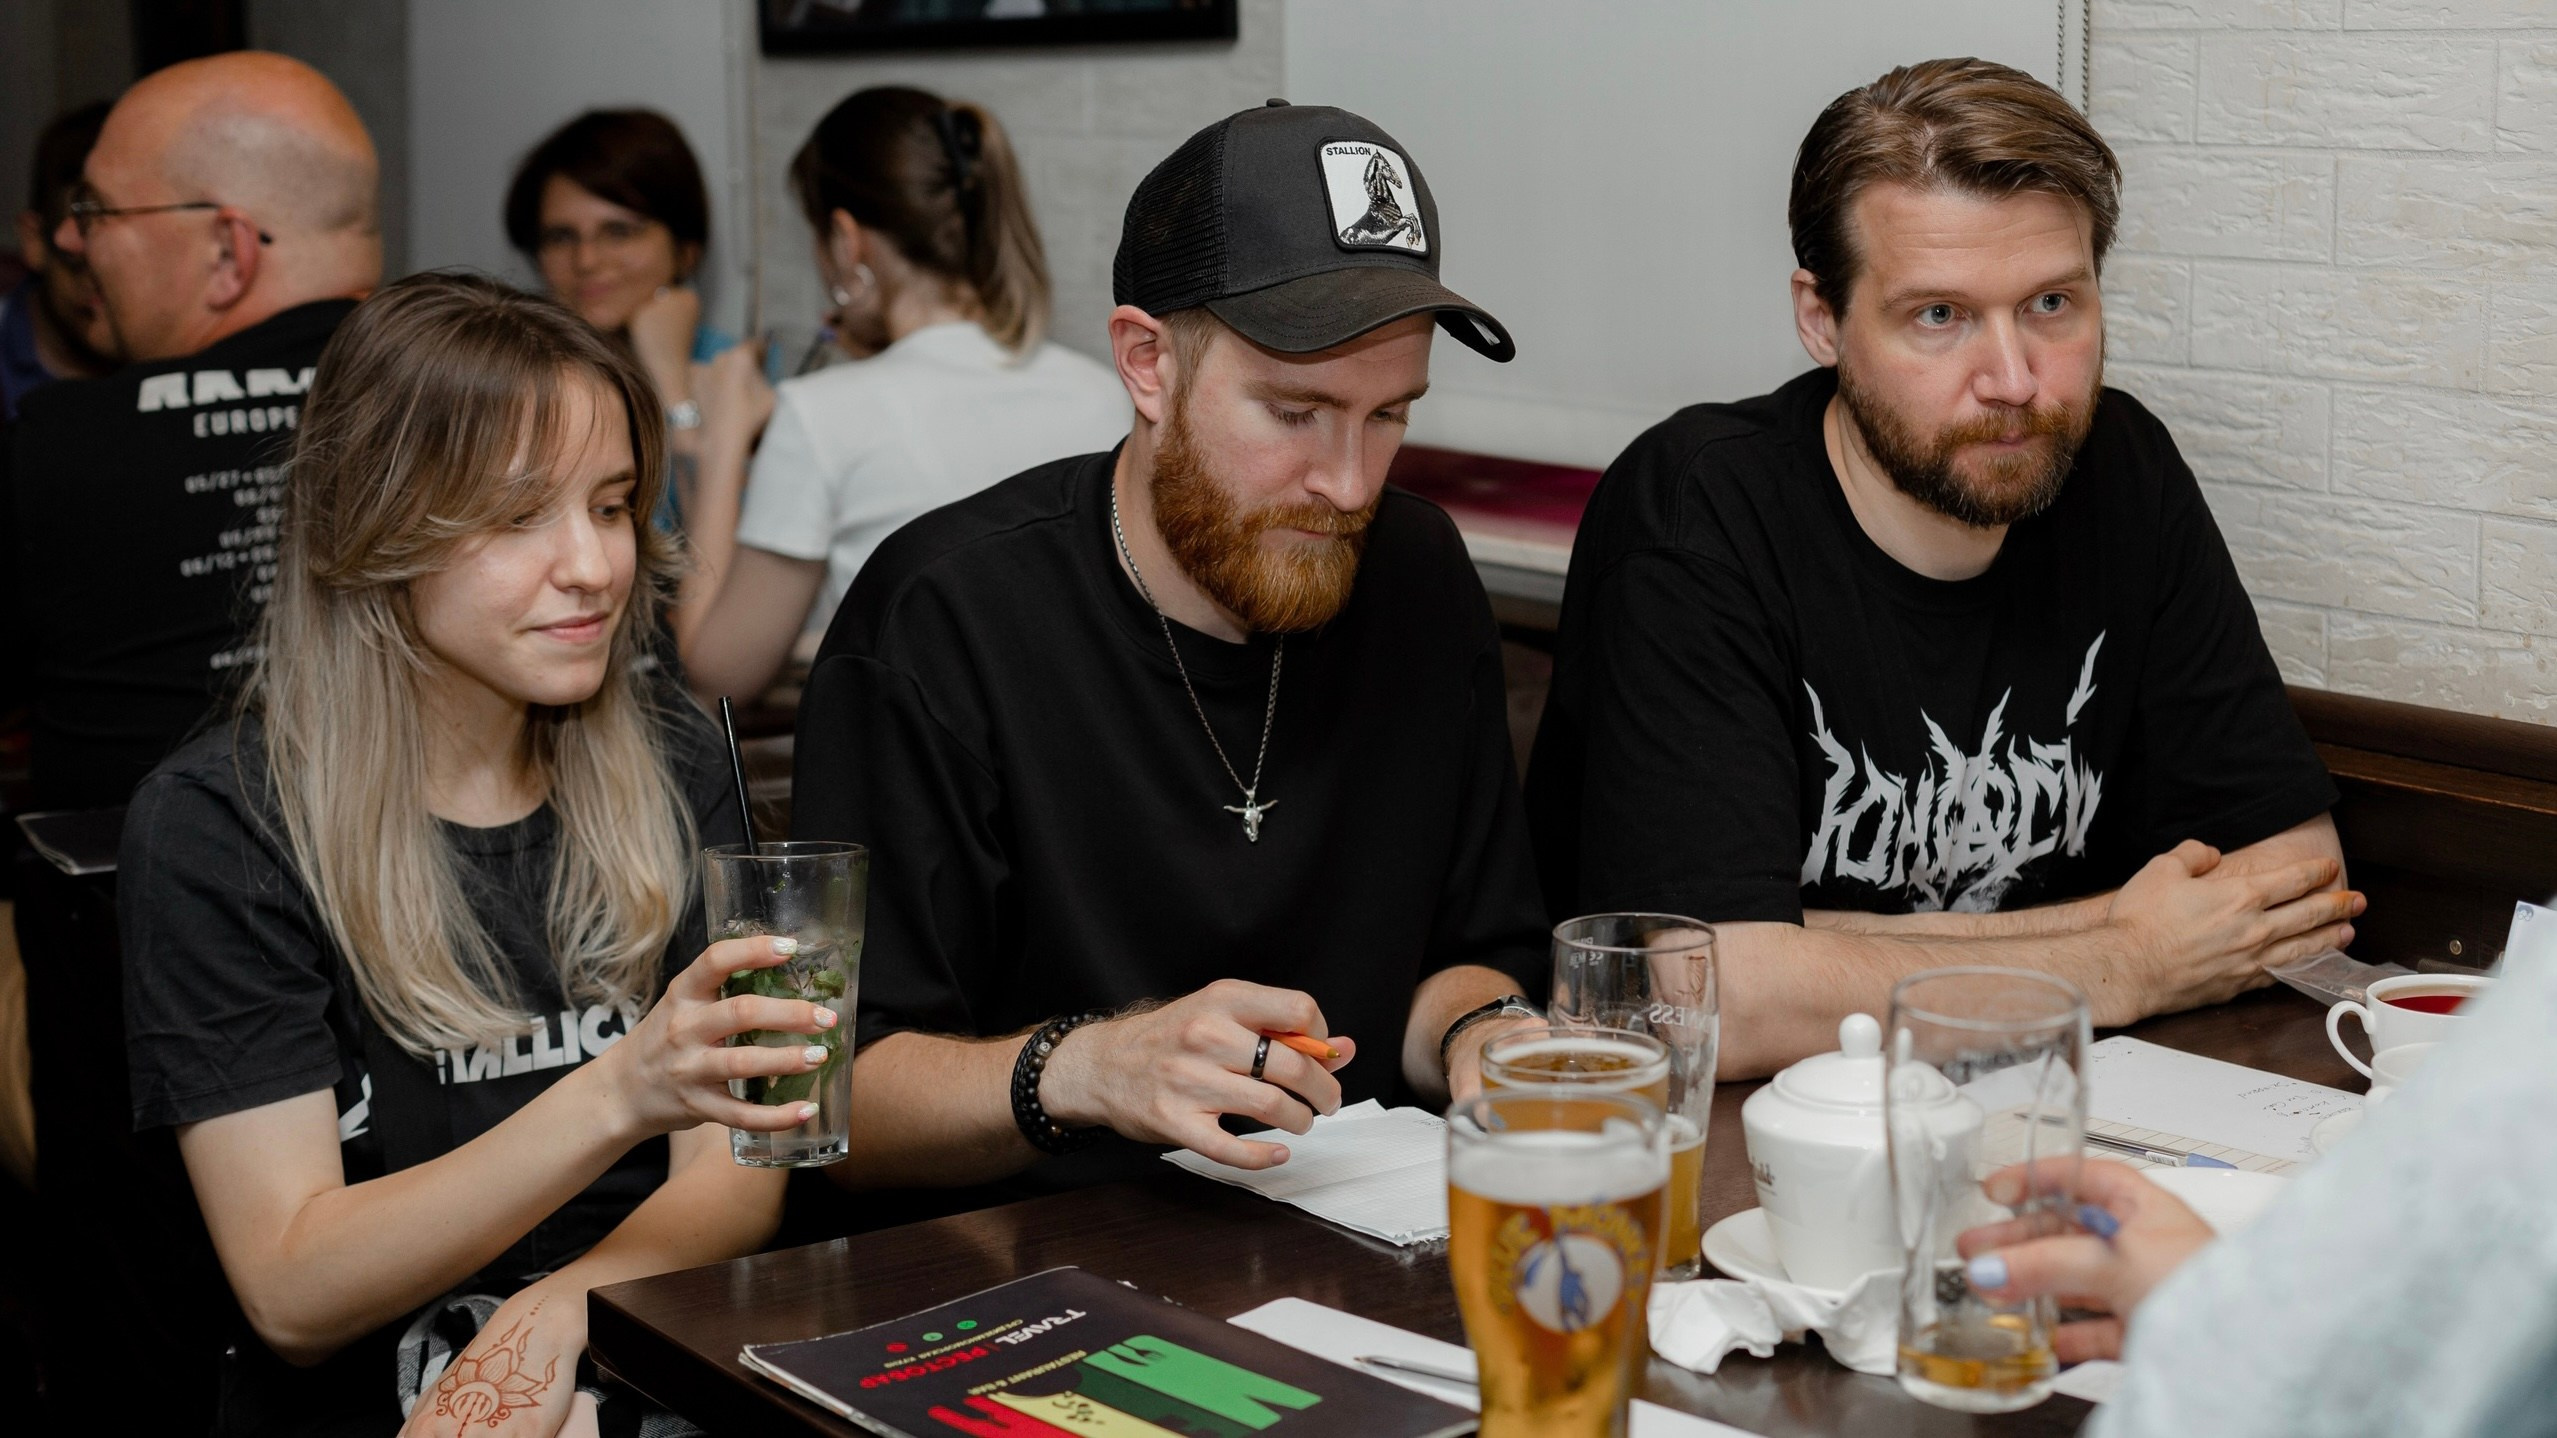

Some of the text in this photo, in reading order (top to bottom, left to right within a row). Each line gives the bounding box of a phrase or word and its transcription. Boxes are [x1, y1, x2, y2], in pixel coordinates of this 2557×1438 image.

[1326, 146, 1371, 156] STALLION
[435, 1003, 642, 1086] TALLIC
[994, 1308, 1087, 1345] TRAVEL
[1008, 1350, 1087, 1385] RESTAURANT
